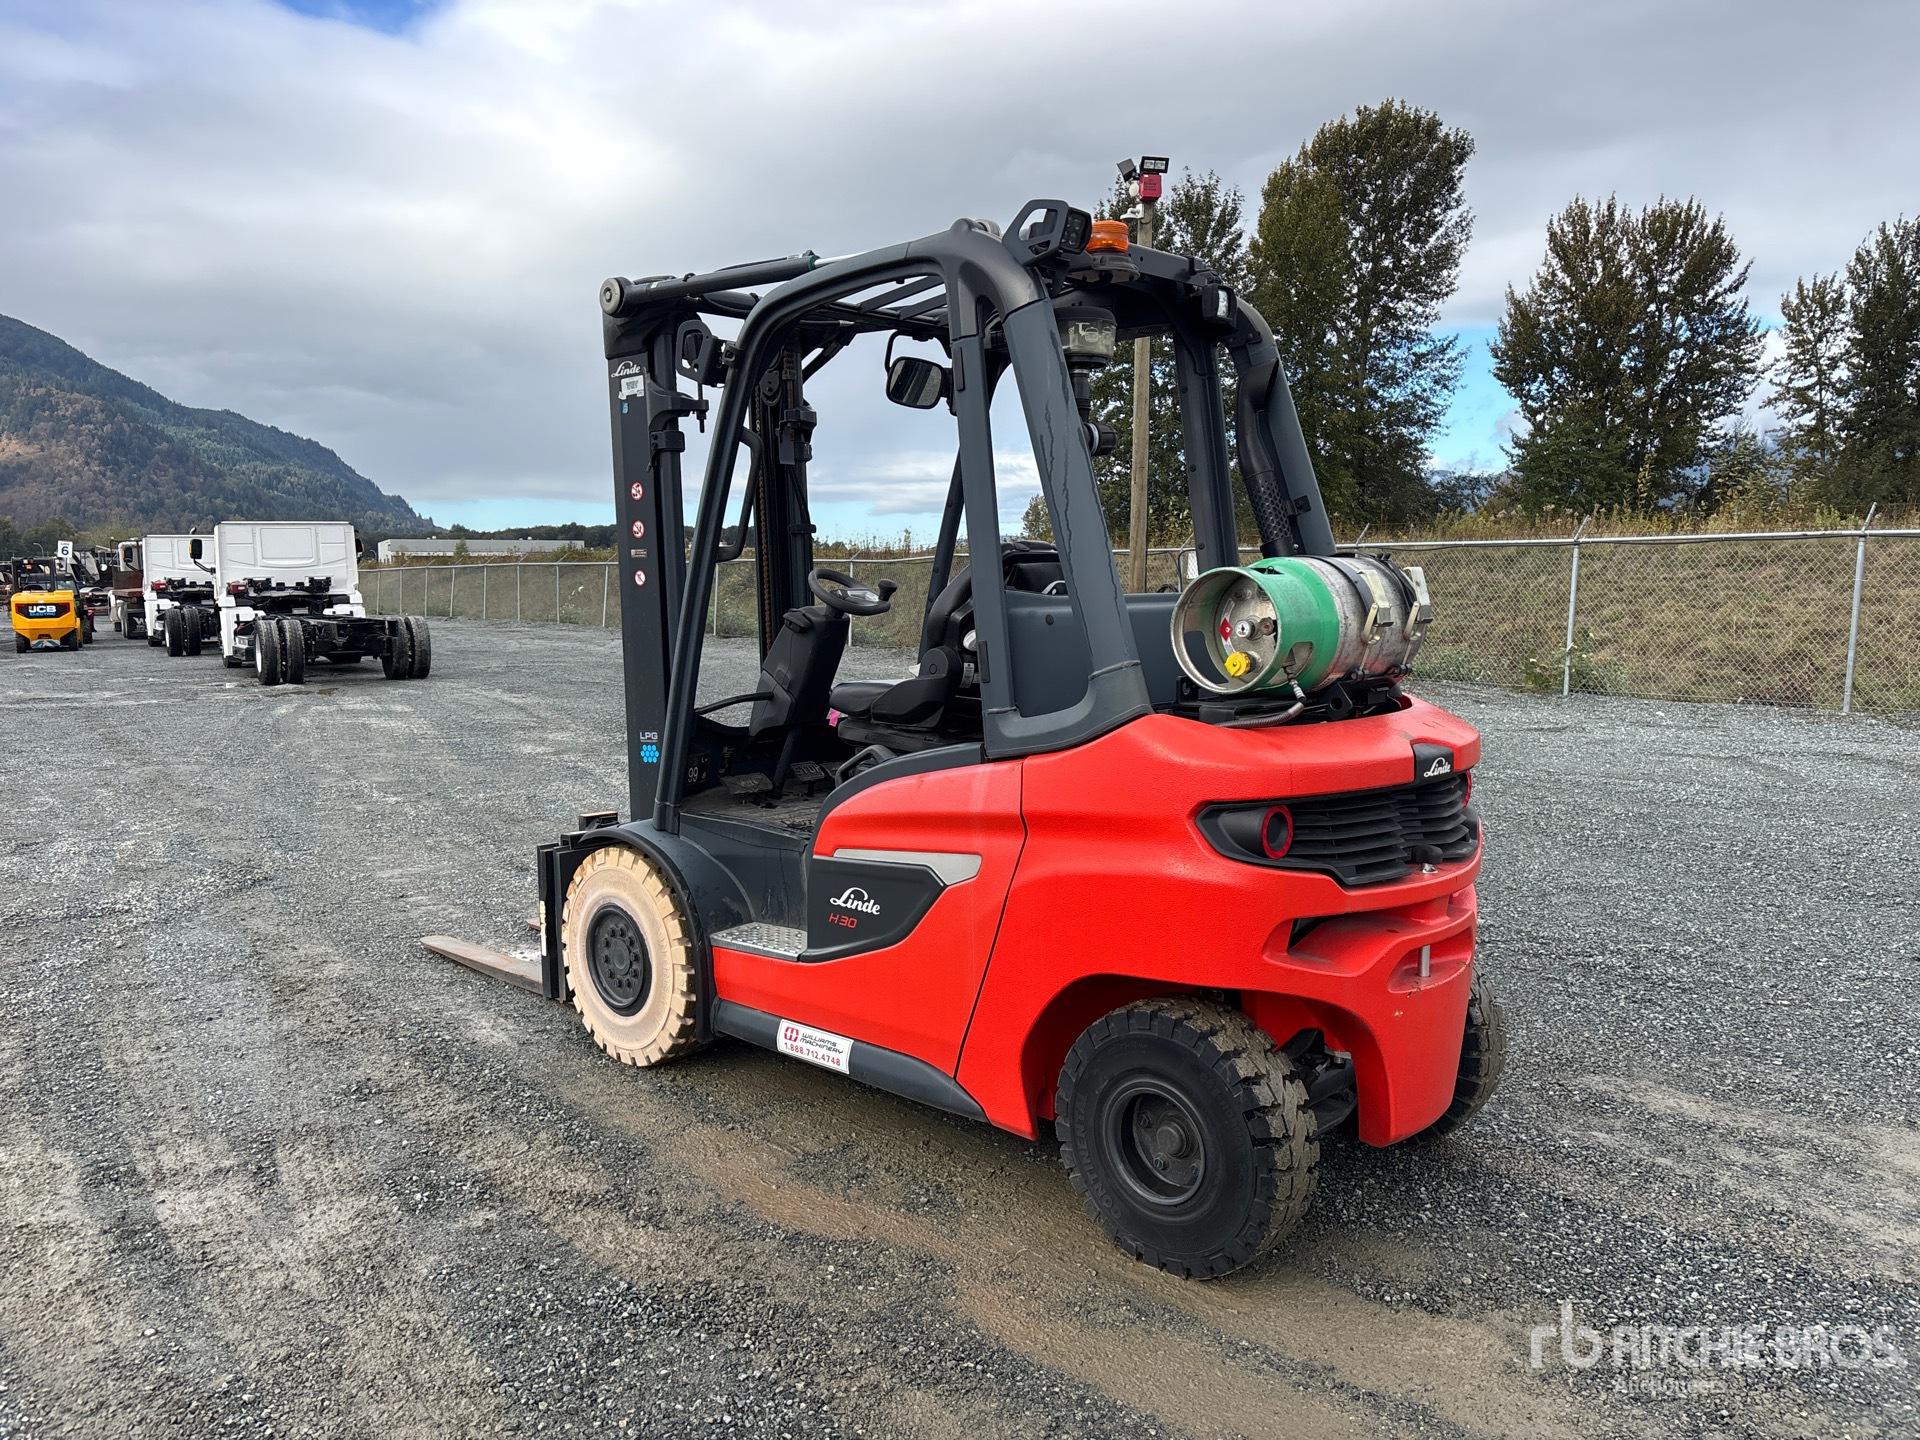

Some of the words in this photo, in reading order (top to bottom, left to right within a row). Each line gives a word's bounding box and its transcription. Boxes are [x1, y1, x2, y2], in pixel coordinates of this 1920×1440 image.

[611, 360, 641, 378] Linde
[61, 546, 70, 556] 6
[28, 605, 57, 613] JCB
[639, 731, 658, 740] LPG
[688, 766, 699, 783] 99
[1423, 757, 1451, 778] Linde
[829, 886, 881, 916] Linde
[799, 1037, 844, 1055] MACHINERY
[801, 1032, 838, 1047] WILLIAMS
[784, 1042, 841, 1067] 1.888.712.4748
